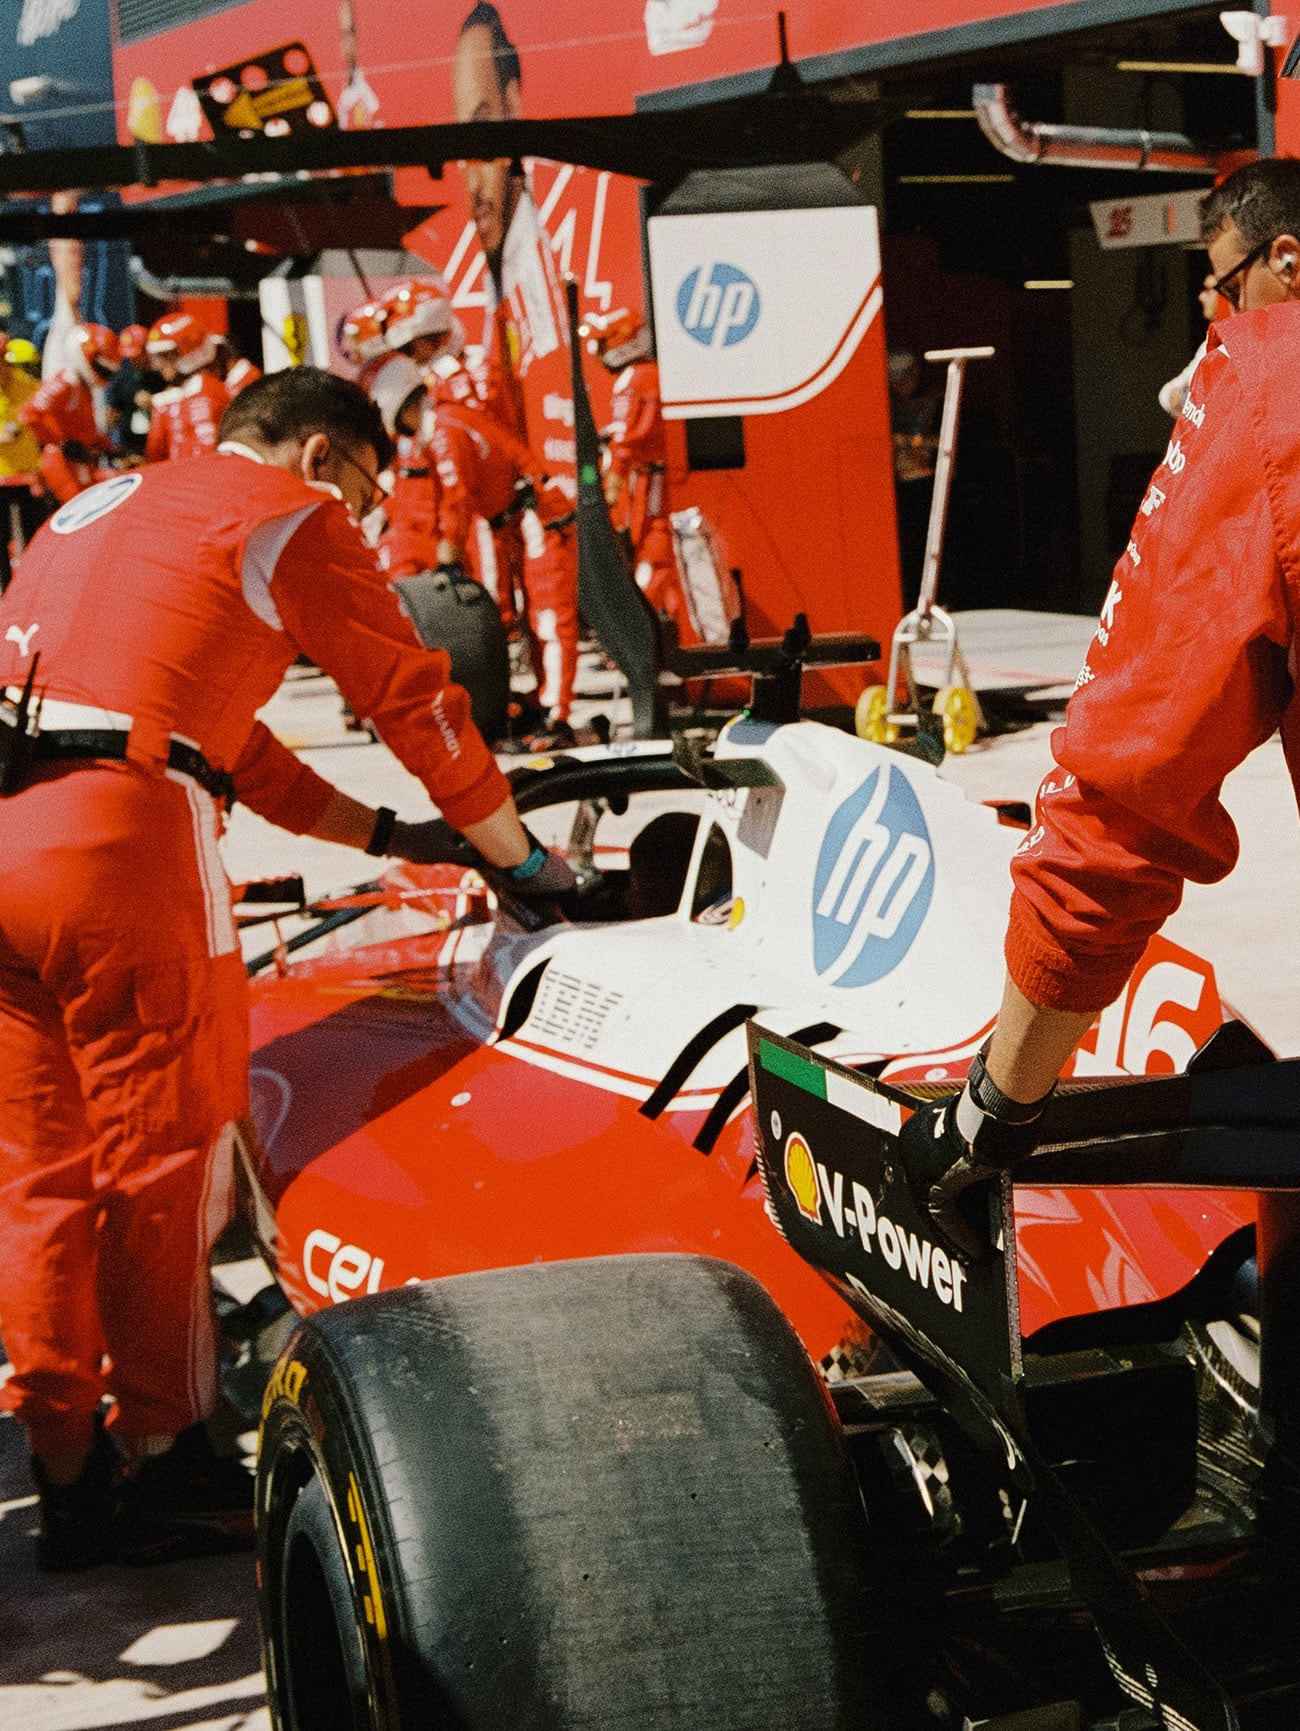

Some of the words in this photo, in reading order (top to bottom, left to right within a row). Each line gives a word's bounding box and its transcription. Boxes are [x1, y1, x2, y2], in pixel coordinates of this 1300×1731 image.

[682, 262, 757, 347] hp
[814, 764, 932, 986] hp
[1071, 961, 1207, 1077] 16
[816, 1162, 967, 1314] V-Power
